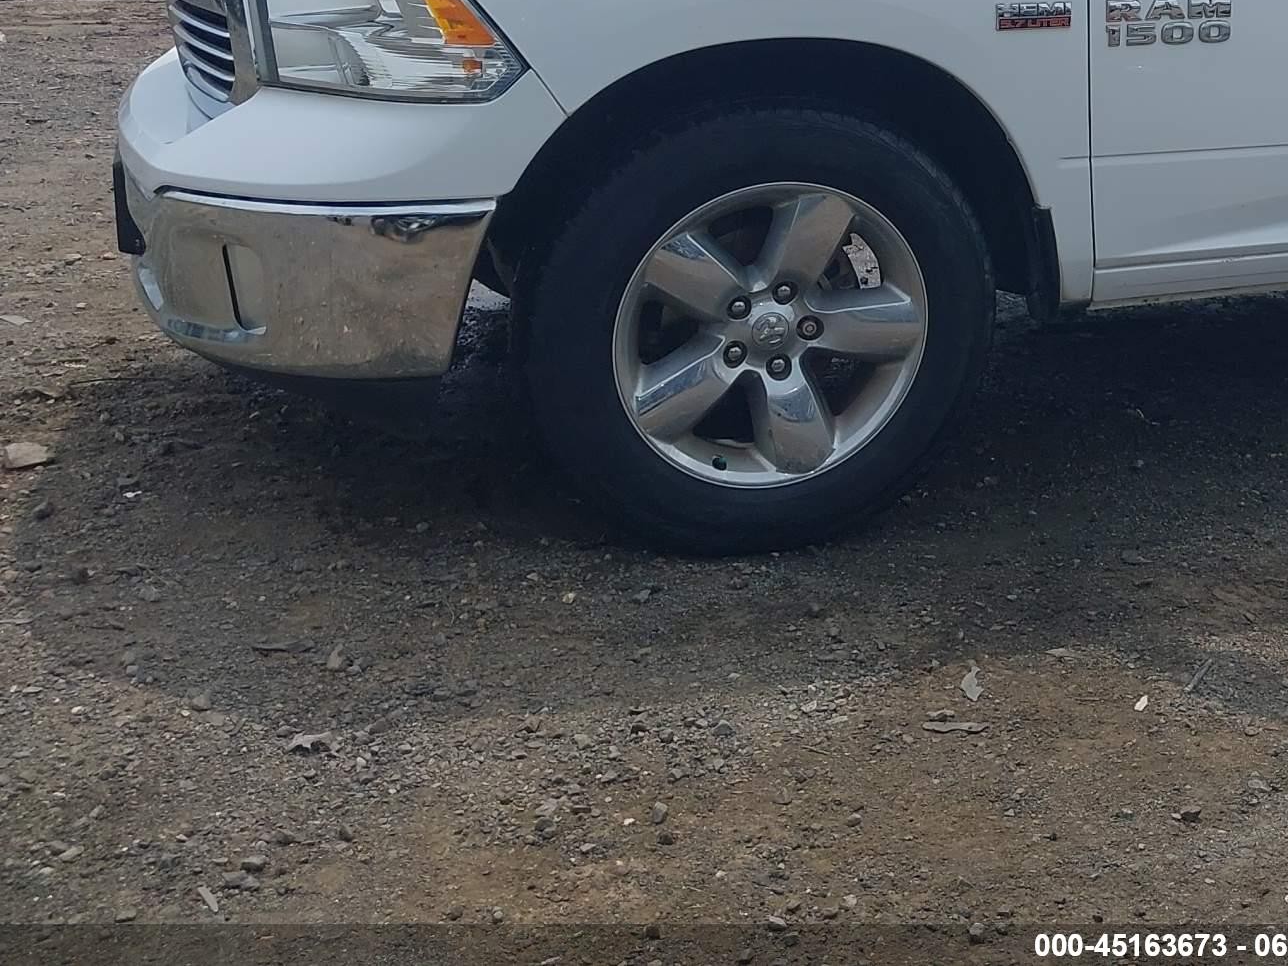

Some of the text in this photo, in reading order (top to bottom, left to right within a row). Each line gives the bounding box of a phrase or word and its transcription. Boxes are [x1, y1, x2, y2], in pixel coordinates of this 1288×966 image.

[996, 1, 1072, 18] HEMI
[1027, 17, 1070, 28] LITER
[1105, 20, 1232, 47] 1500
